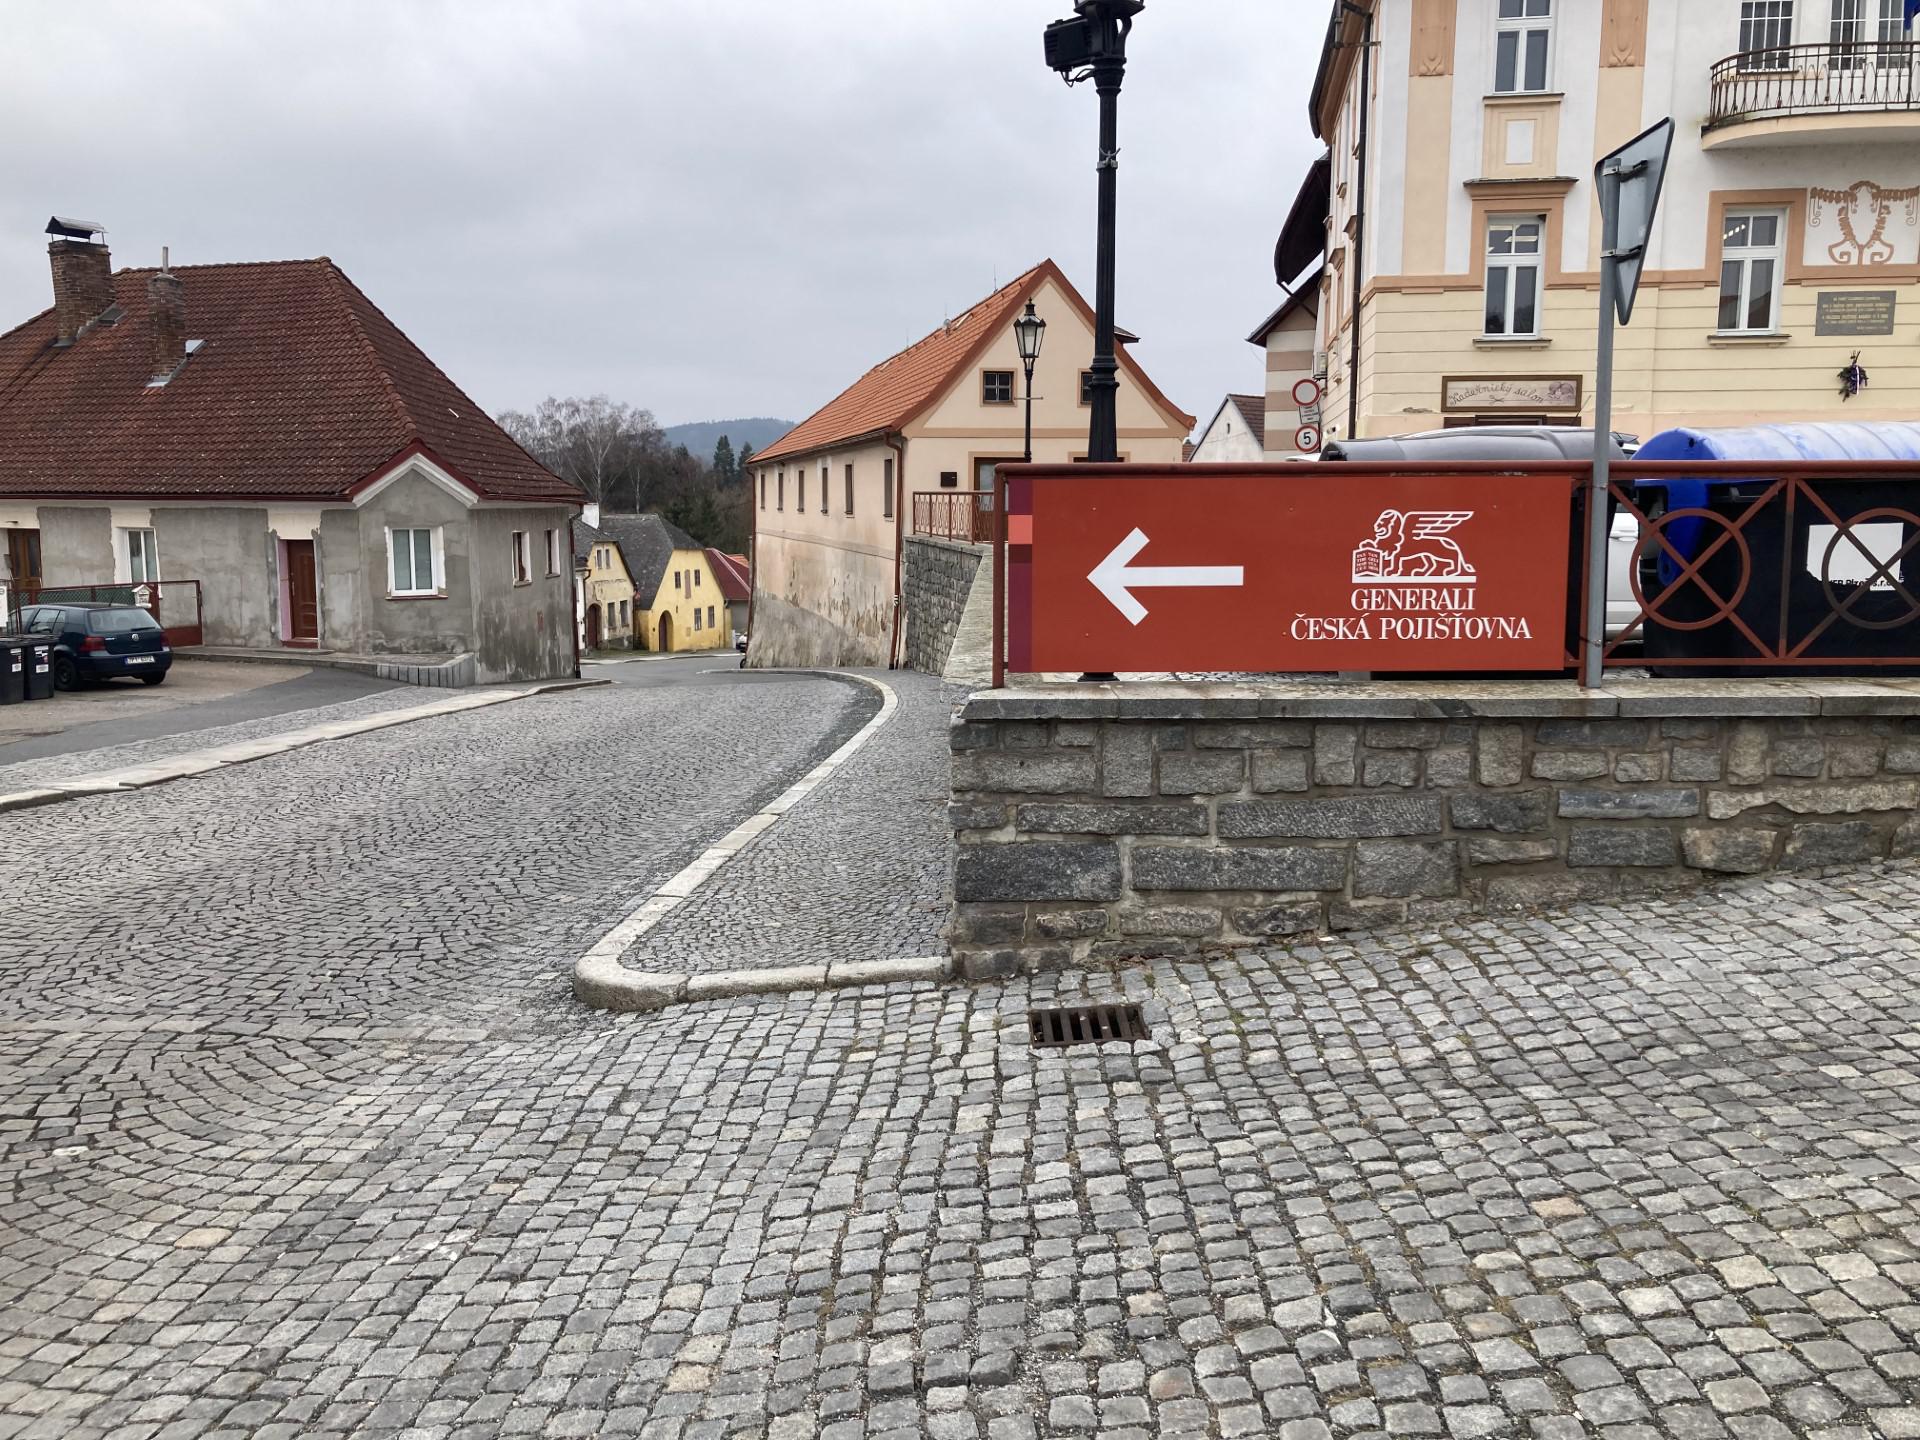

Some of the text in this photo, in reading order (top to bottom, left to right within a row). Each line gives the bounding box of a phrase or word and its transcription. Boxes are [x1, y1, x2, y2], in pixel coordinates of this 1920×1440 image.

[1514, 387, 1544, 404] salon
[1303, 431, 1312, 445] 5
[1350, 587, 1476, 611] GENERALI
[1290, 612, 1533, 640] ČESKÁ POJIŠŤOVNA
